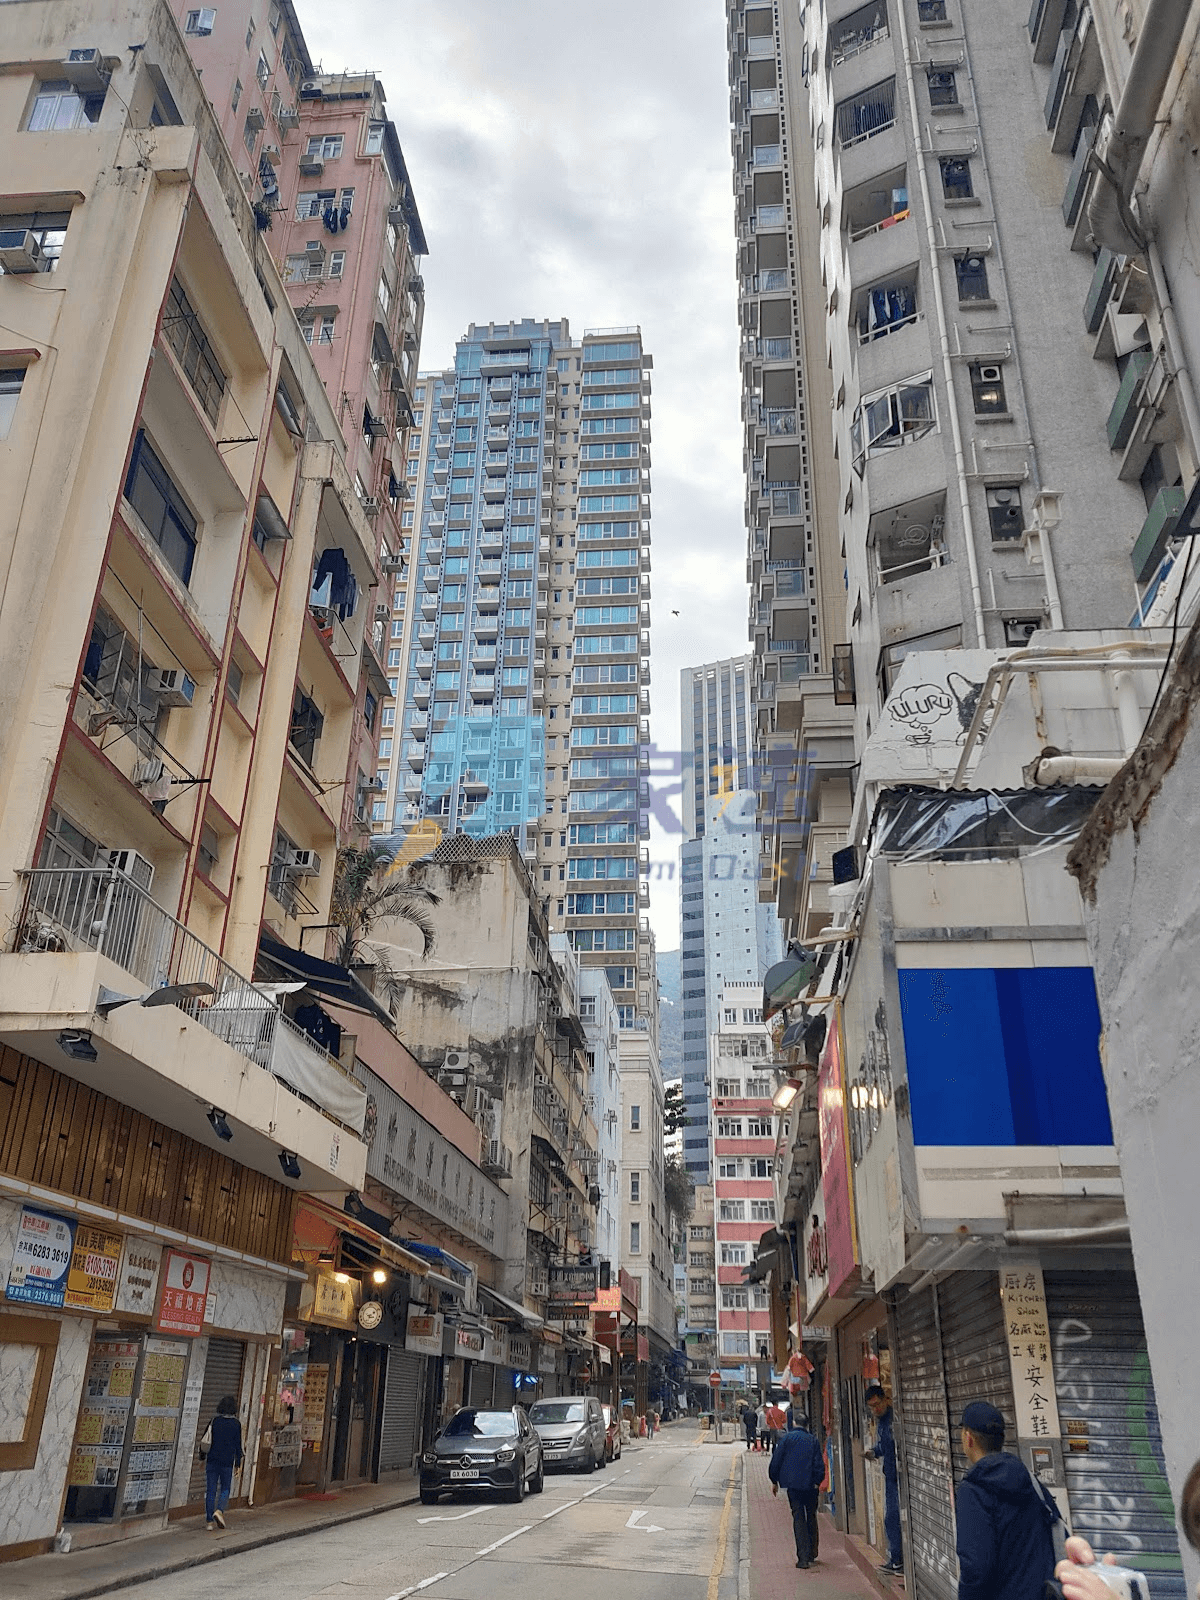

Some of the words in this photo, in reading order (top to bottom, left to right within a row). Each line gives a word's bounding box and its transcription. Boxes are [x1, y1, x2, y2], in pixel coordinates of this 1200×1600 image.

[891, 695, 950, 719] ULURU
[33, 1243, 51, 1260] 6283
[51, 1248, 69, 1264] 3619
[163, 1290, 204, 1313] 天福地產
[1024, 1364, 1050, 1437] 安全鞋
[461, 1470, 478, 1478] 6030
